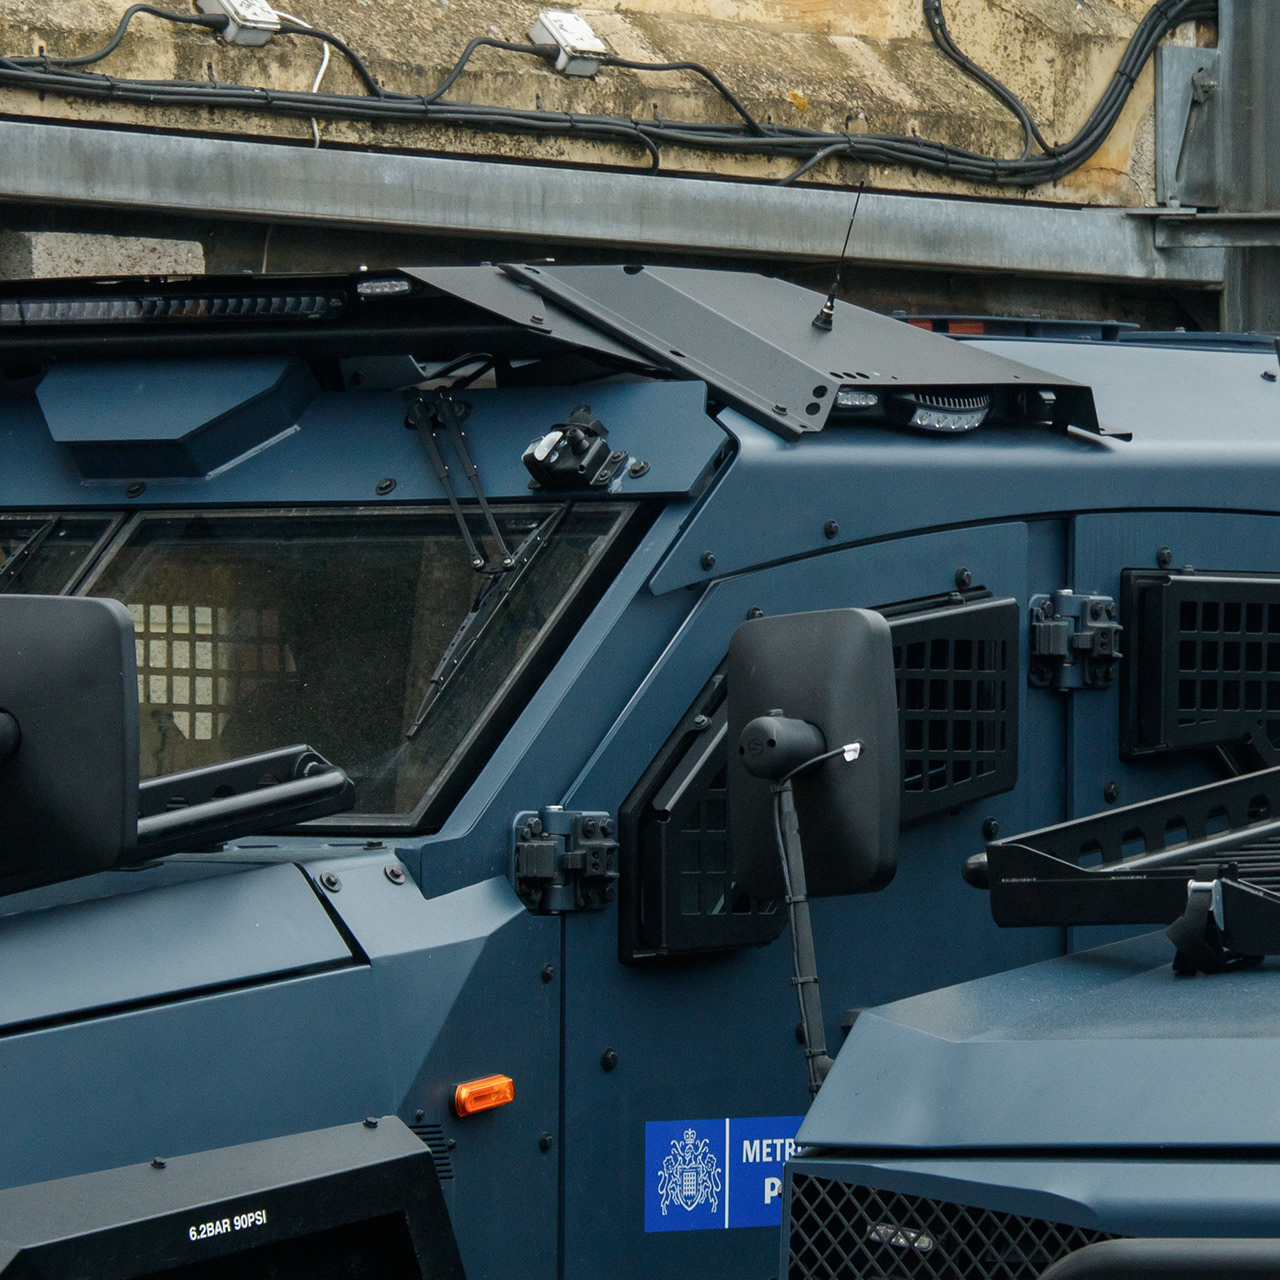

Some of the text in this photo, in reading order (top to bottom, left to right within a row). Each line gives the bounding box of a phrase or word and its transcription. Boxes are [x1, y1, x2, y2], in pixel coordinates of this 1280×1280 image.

[742, 1138, 800, 1163] METR
[189, 1209, 267, 1241] 6.2BAR 90PSI
